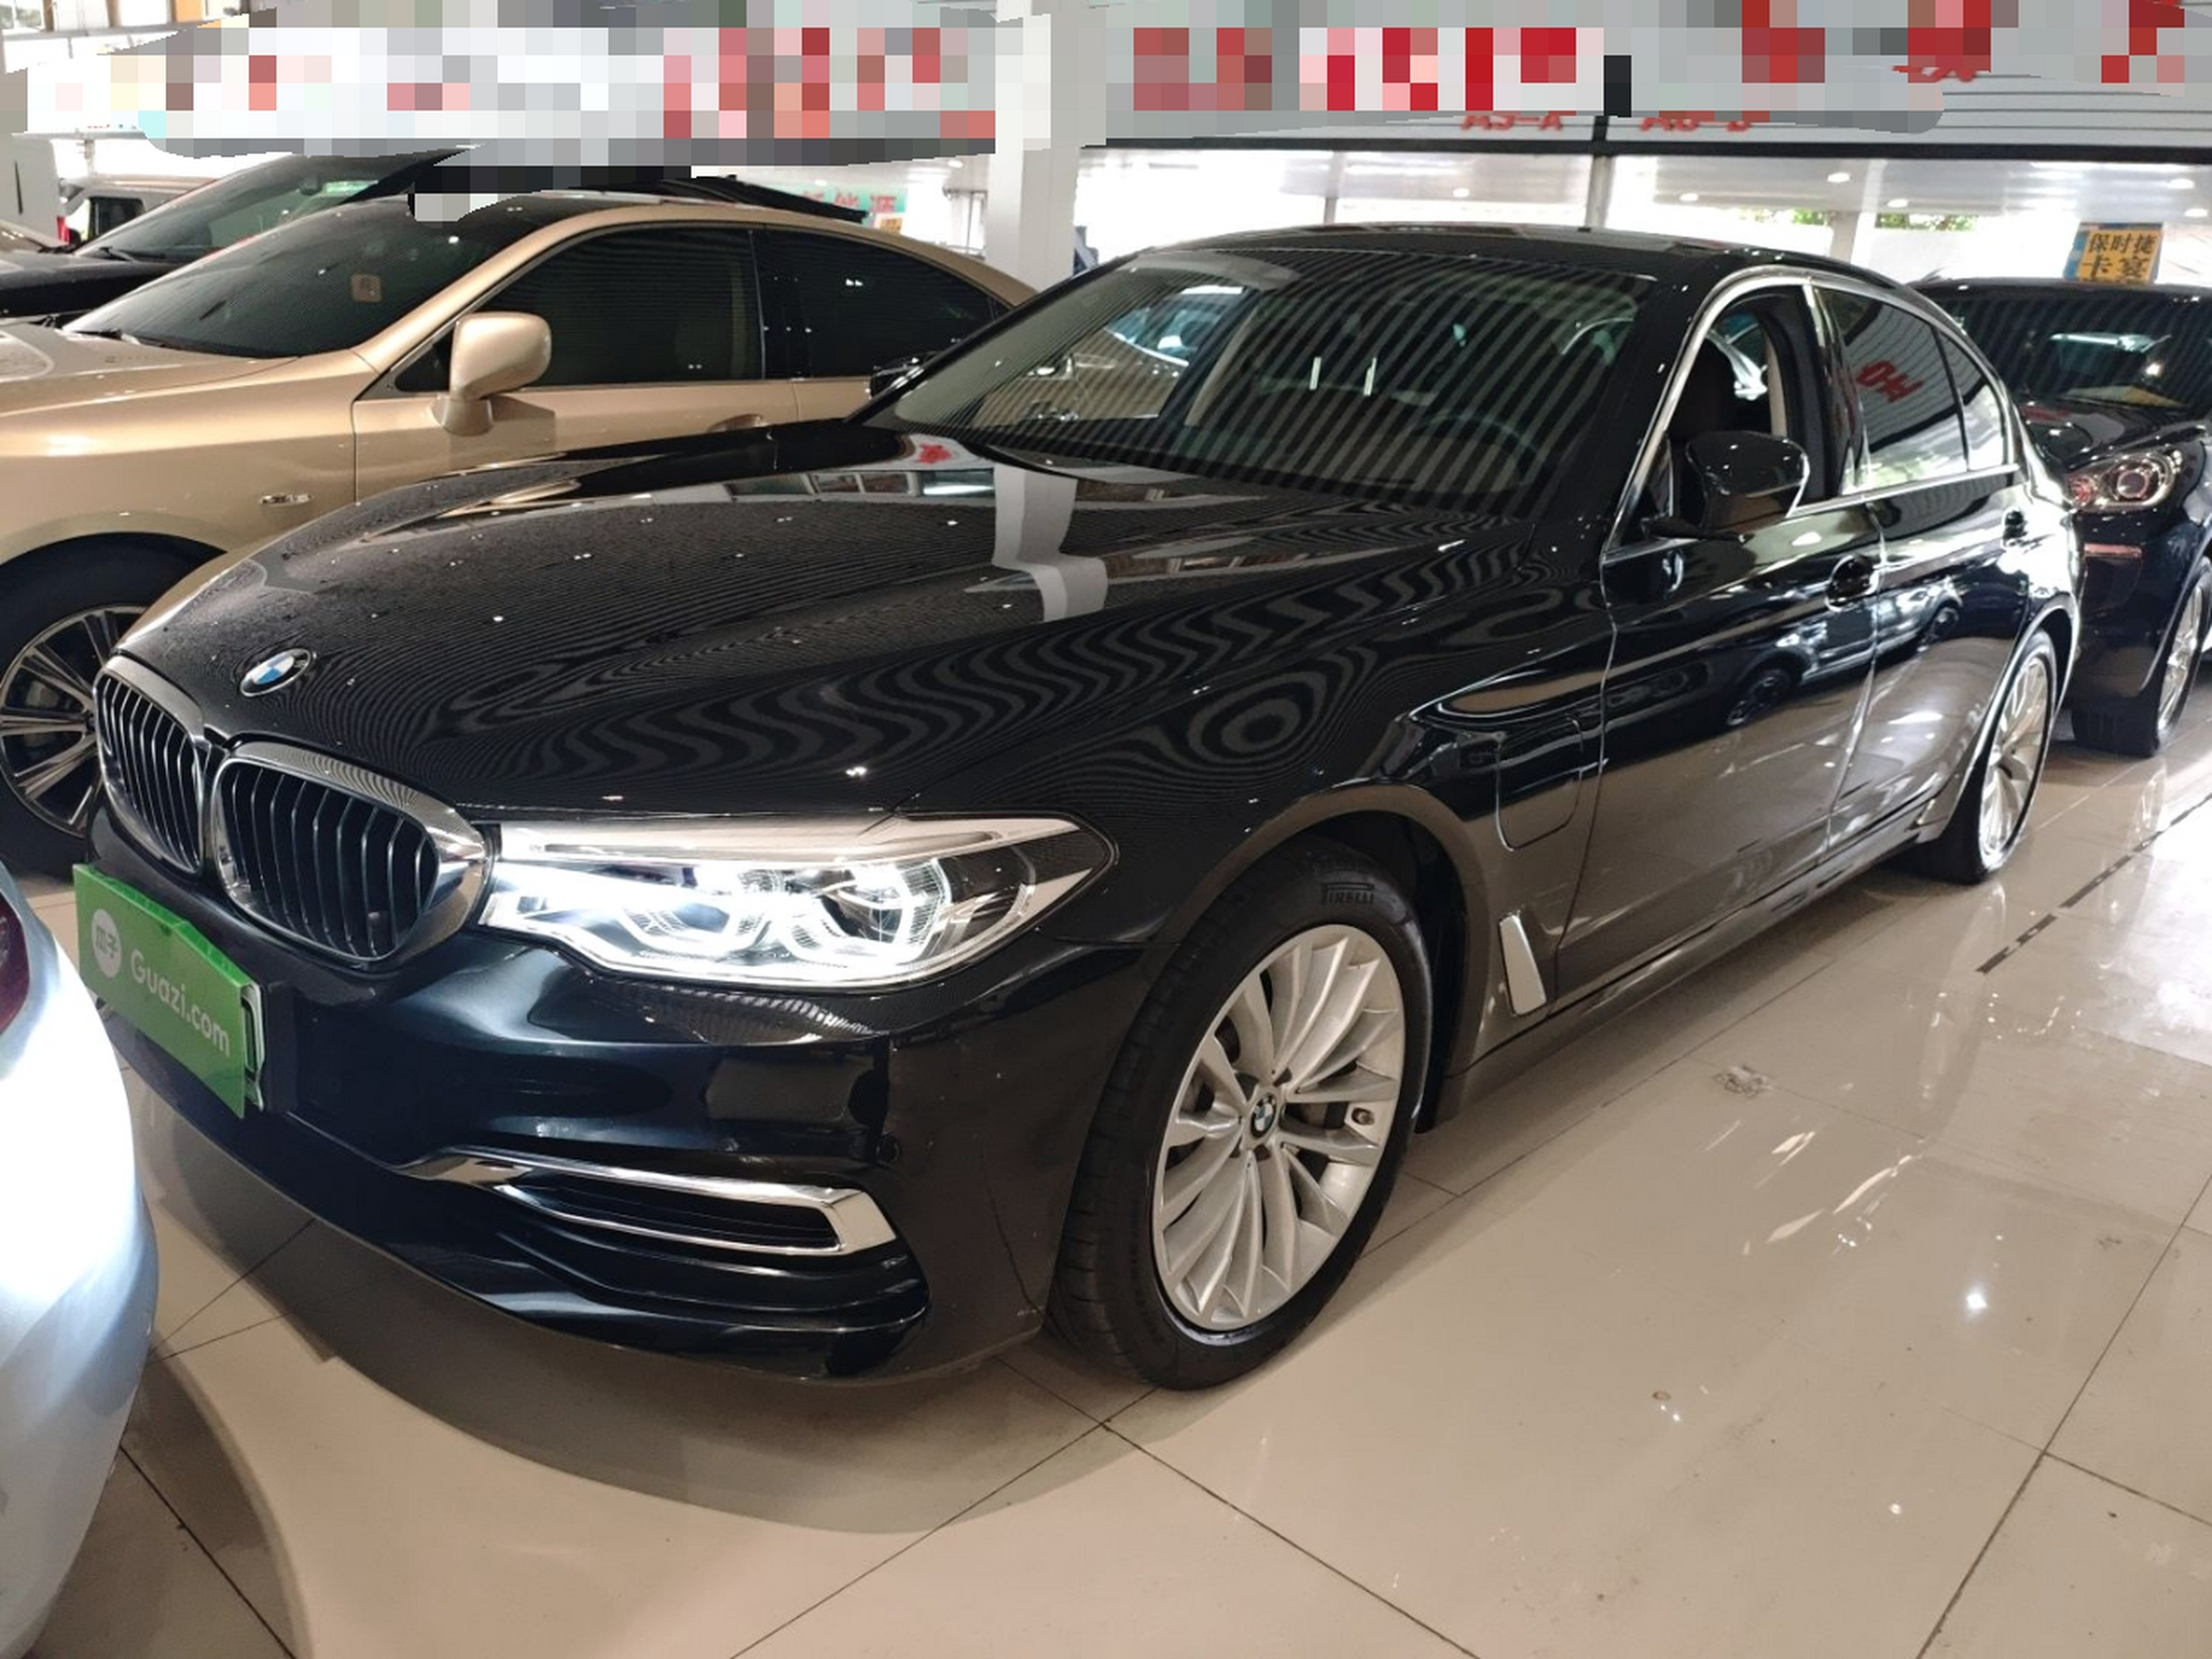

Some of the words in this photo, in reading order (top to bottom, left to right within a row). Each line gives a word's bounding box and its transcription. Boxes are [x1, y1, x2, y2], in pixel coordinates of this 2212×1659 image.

[2088, 232, 2158, 254] 保时捷
[1320, 882, 1374, 904] PIRELLI
[130, 948, 230, 1057] Guazi.com
